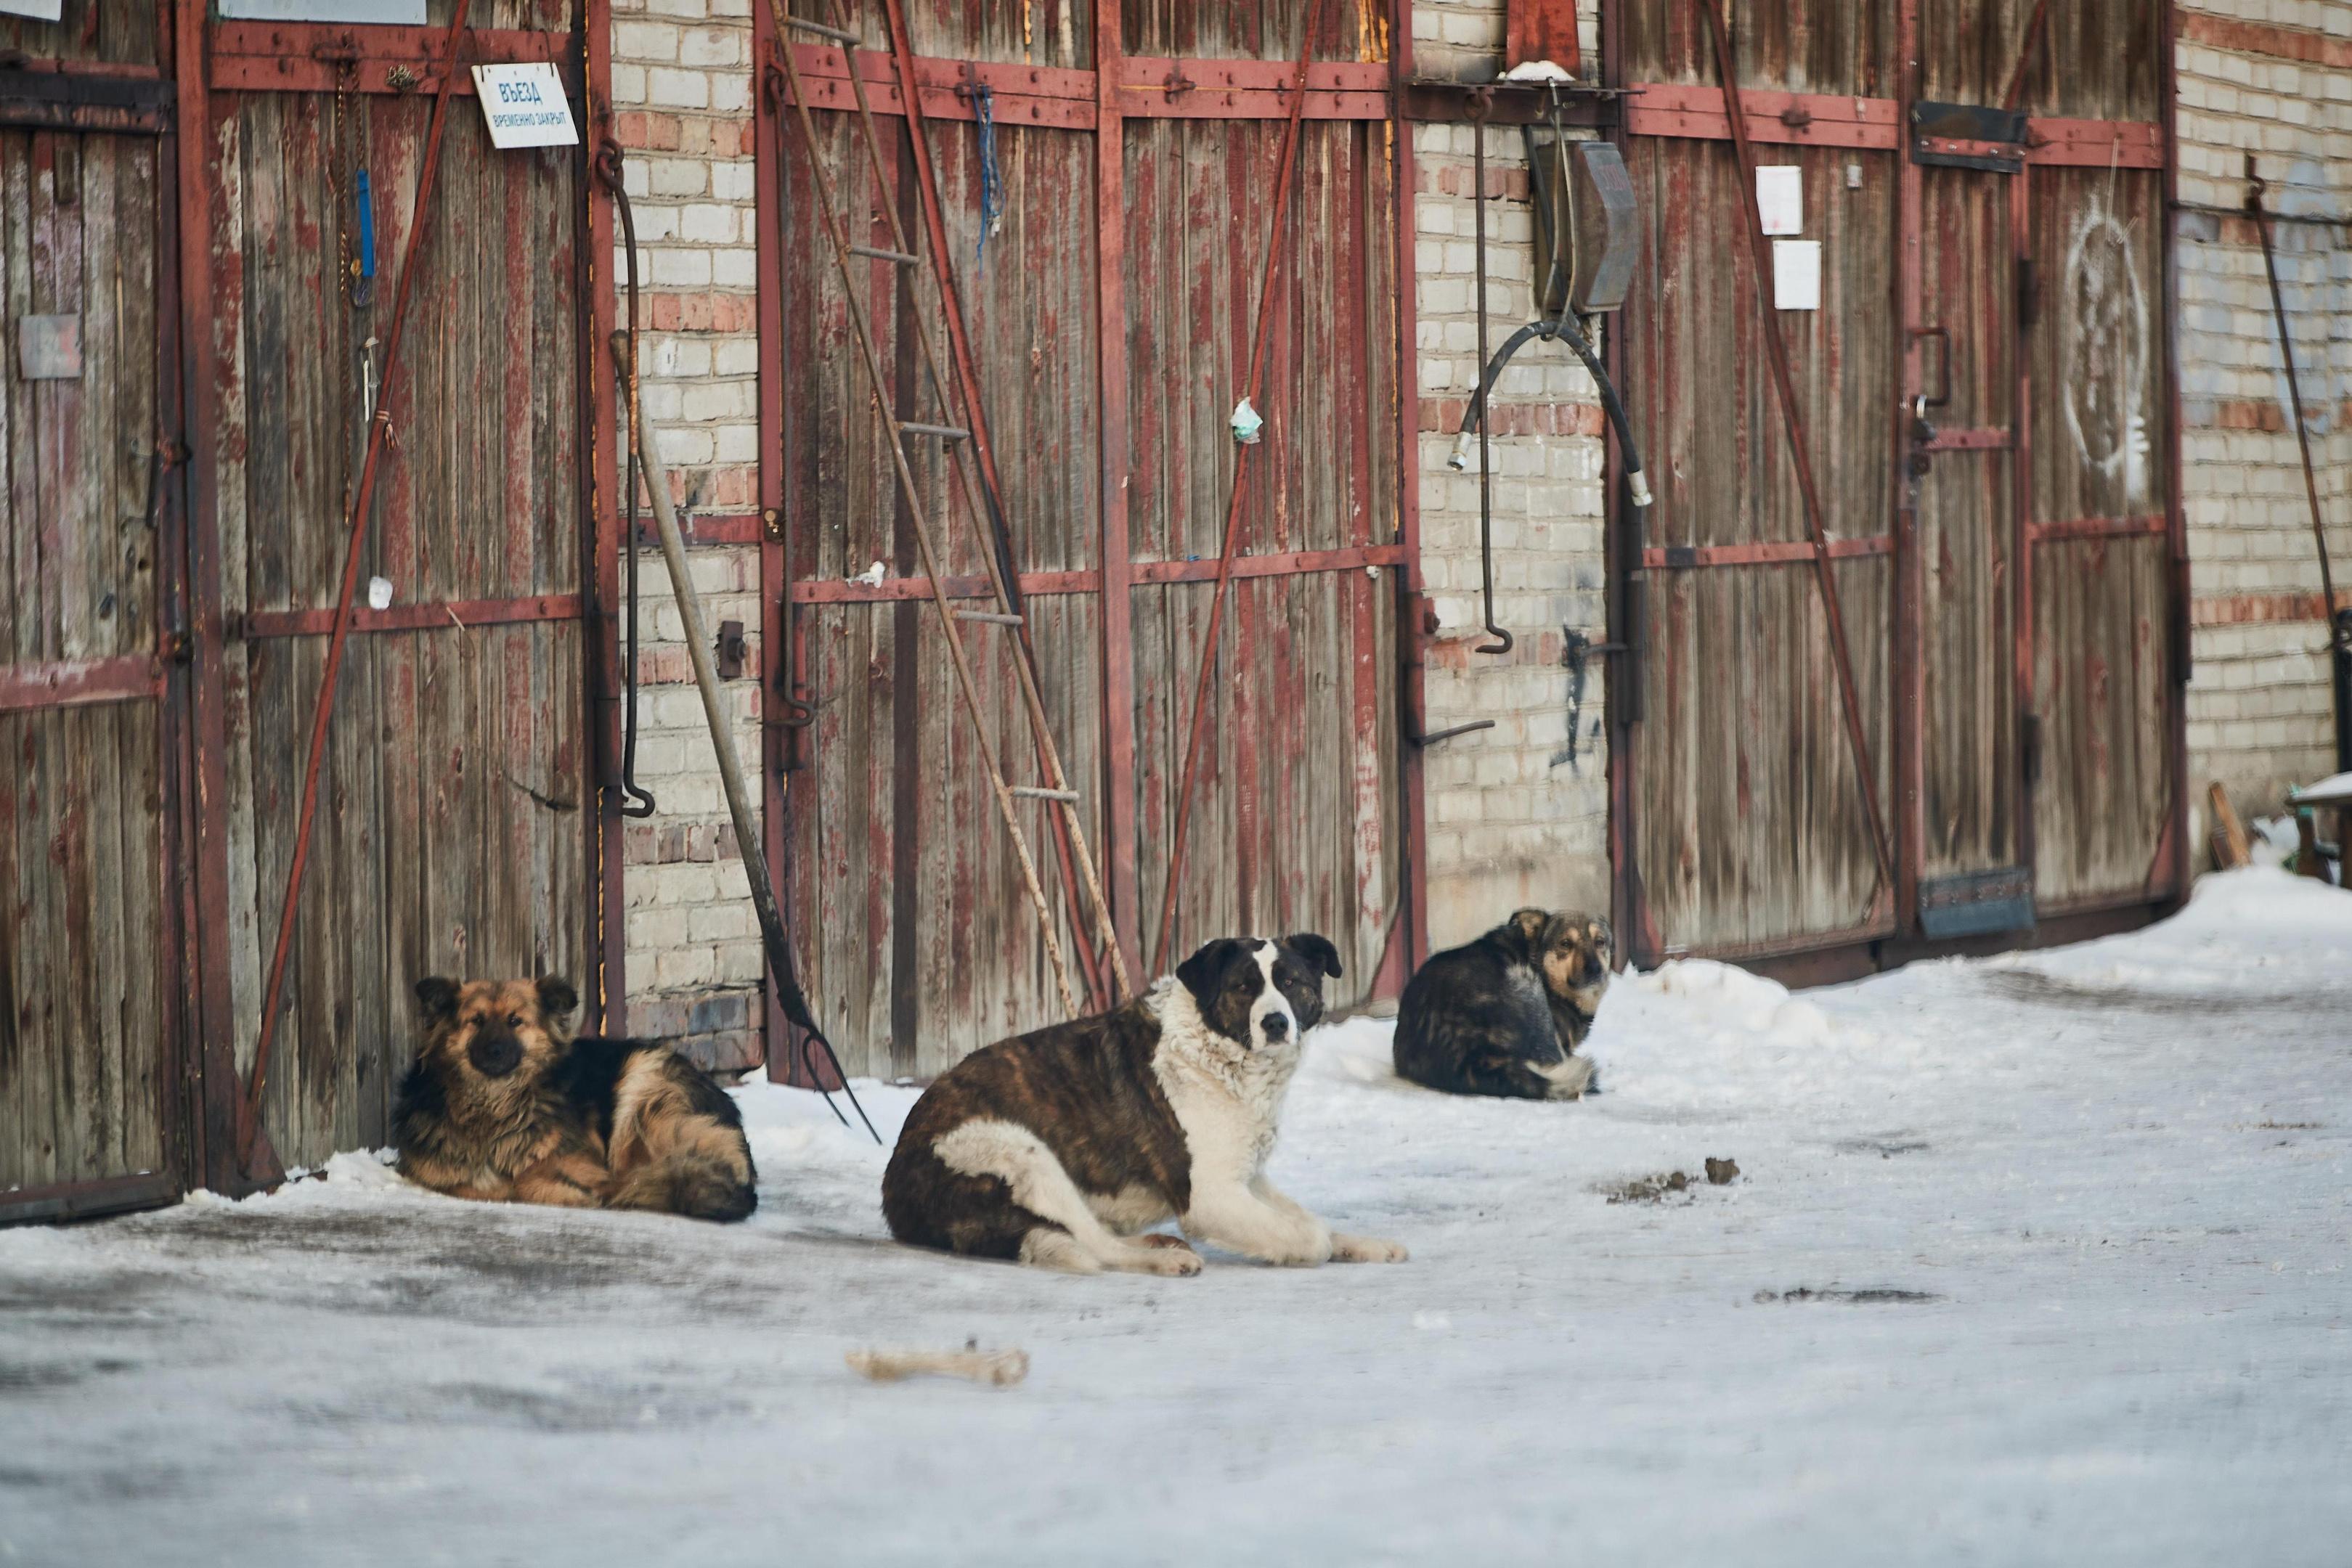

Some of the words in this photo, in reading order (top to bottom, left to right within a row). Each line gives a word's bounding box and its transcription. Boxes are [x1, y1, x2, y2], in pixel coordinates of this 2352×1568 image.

[499, 81, 543, 105] ВЪЕЗД
[492, 113, 535, 128] ВРЕМЕННО
[535, 111, 566, 126] ЗАКРЫТ
